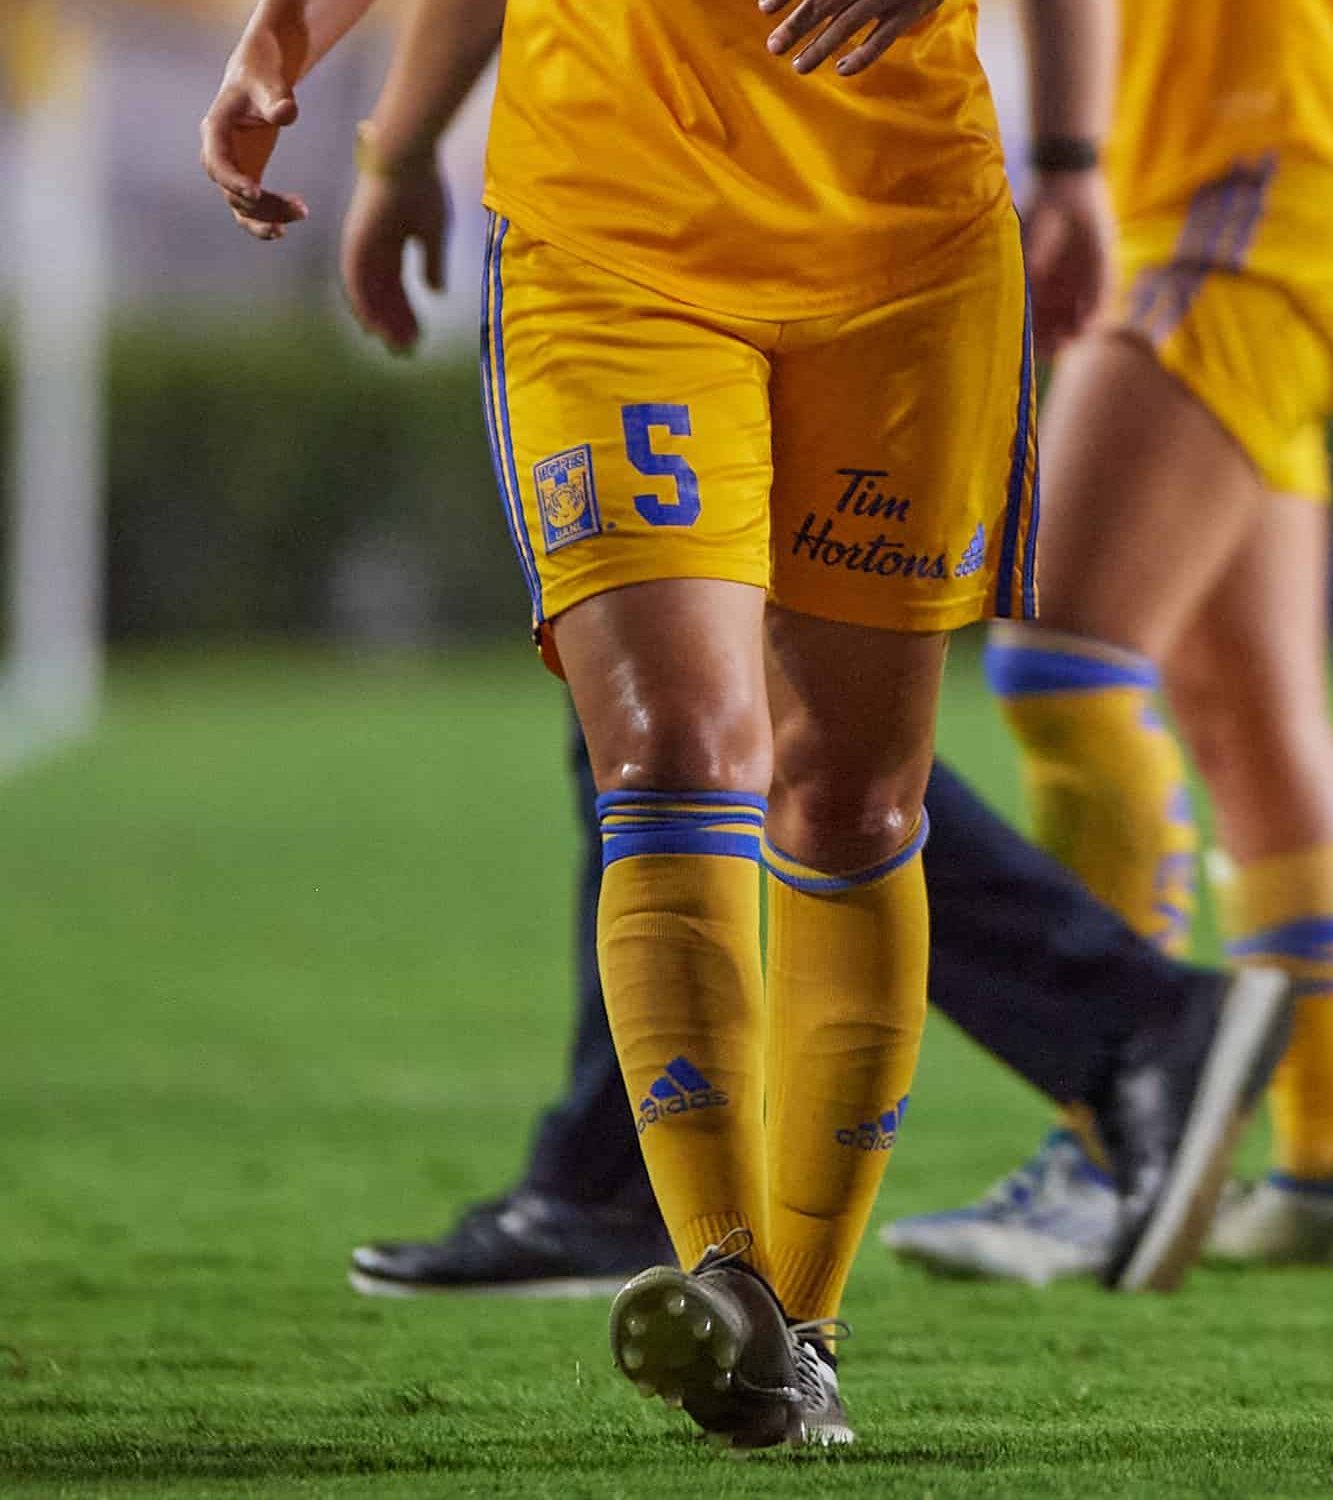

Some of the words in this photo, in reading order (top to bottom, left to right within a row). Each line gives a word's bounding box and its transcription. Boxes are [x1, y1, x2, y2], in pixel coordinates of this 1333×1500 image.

[621, 403, 702, 528] 5
[836, 468, 911, 522] Tim
[791, 512, 950, 581] Hortons
[638, 1088, 729, 1135] adidas
[834, 1128, 897, 1151] adid
